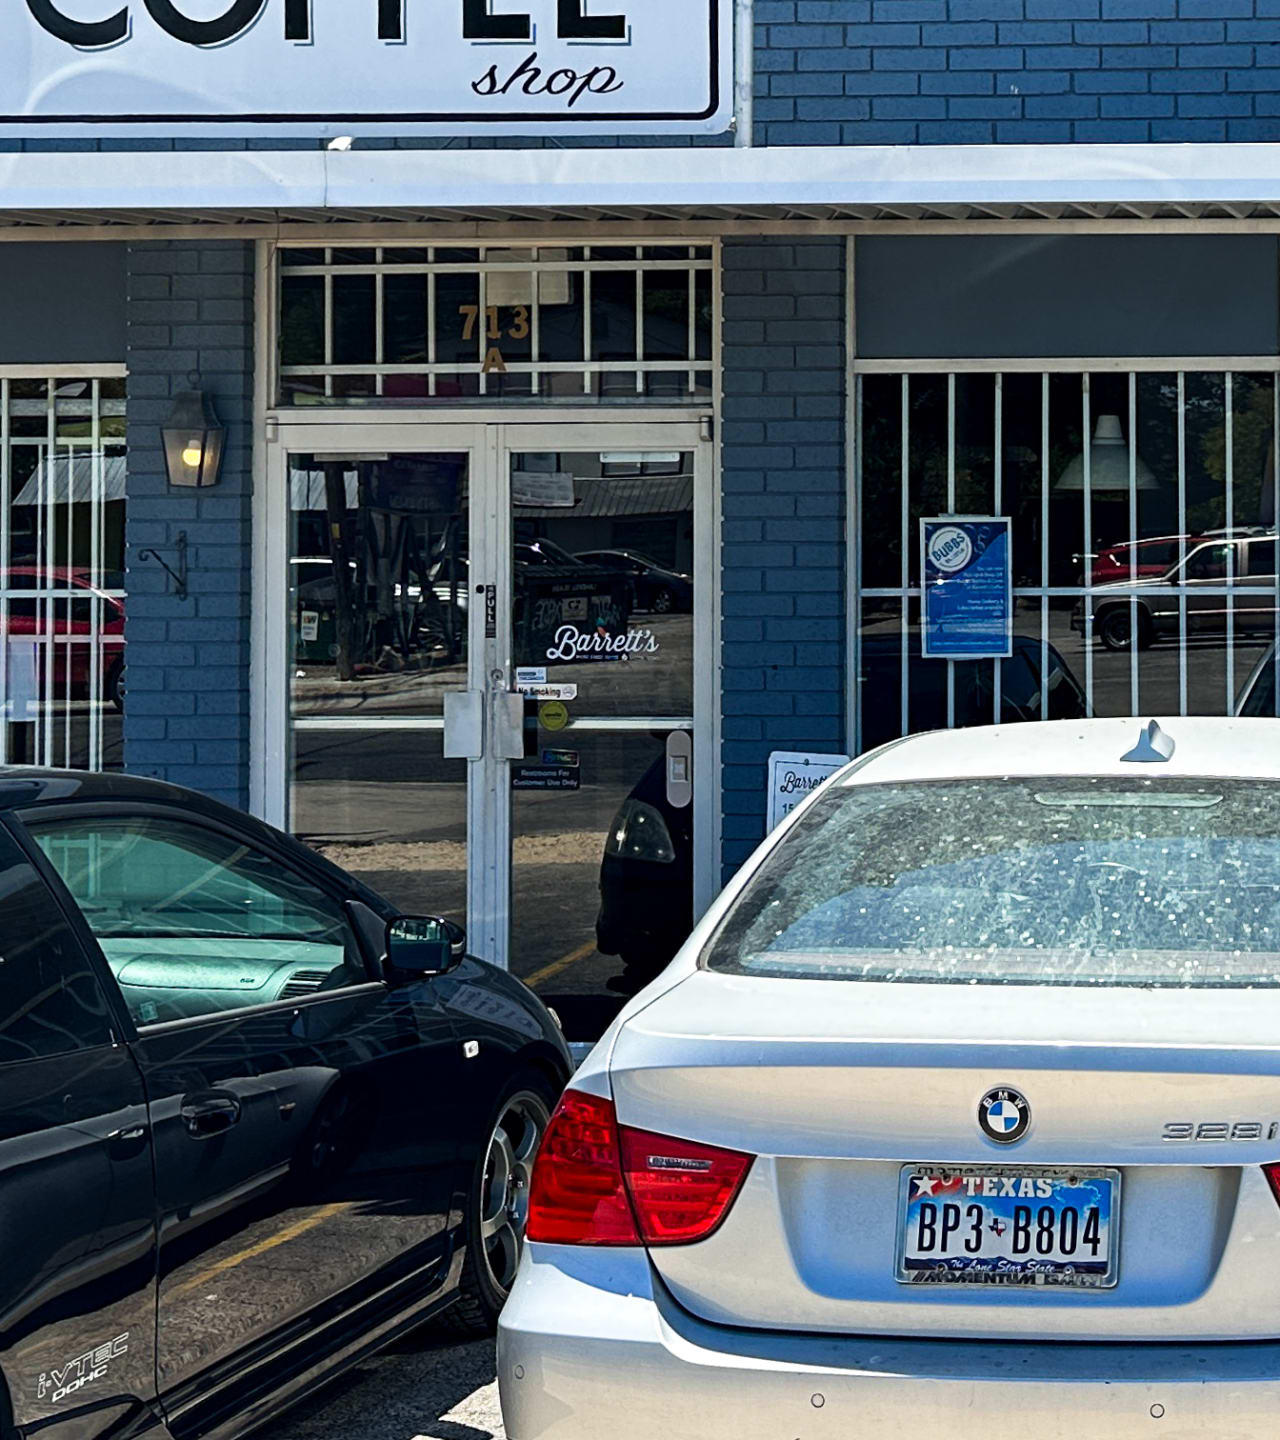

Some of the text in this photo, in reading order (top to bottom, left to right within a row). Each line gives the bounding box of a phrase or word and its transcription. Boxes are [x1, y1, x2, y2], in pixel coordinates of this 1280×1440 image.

[470, 52, 624, 108] shop
[458, 304, 529, 340] 713
[481, 347, 507, 373] A
[487, 591, 495, 623] PULL
[546, 624, 660, 660] Barrett's
[530, 687, 561, 698] Smoking
[982, 1090, 1026, 1109] BMW
[1162, 1122, 1279, 1142] 328i
[963, 1176, 1053, 1199] TEXAS
[964, 1259, 993, 1273] Lone
[996, 1260, 1022, 1274] Star
[1024, 1260, 1056, 1274] State
[52, 1364, 108, 1402] DOHC
